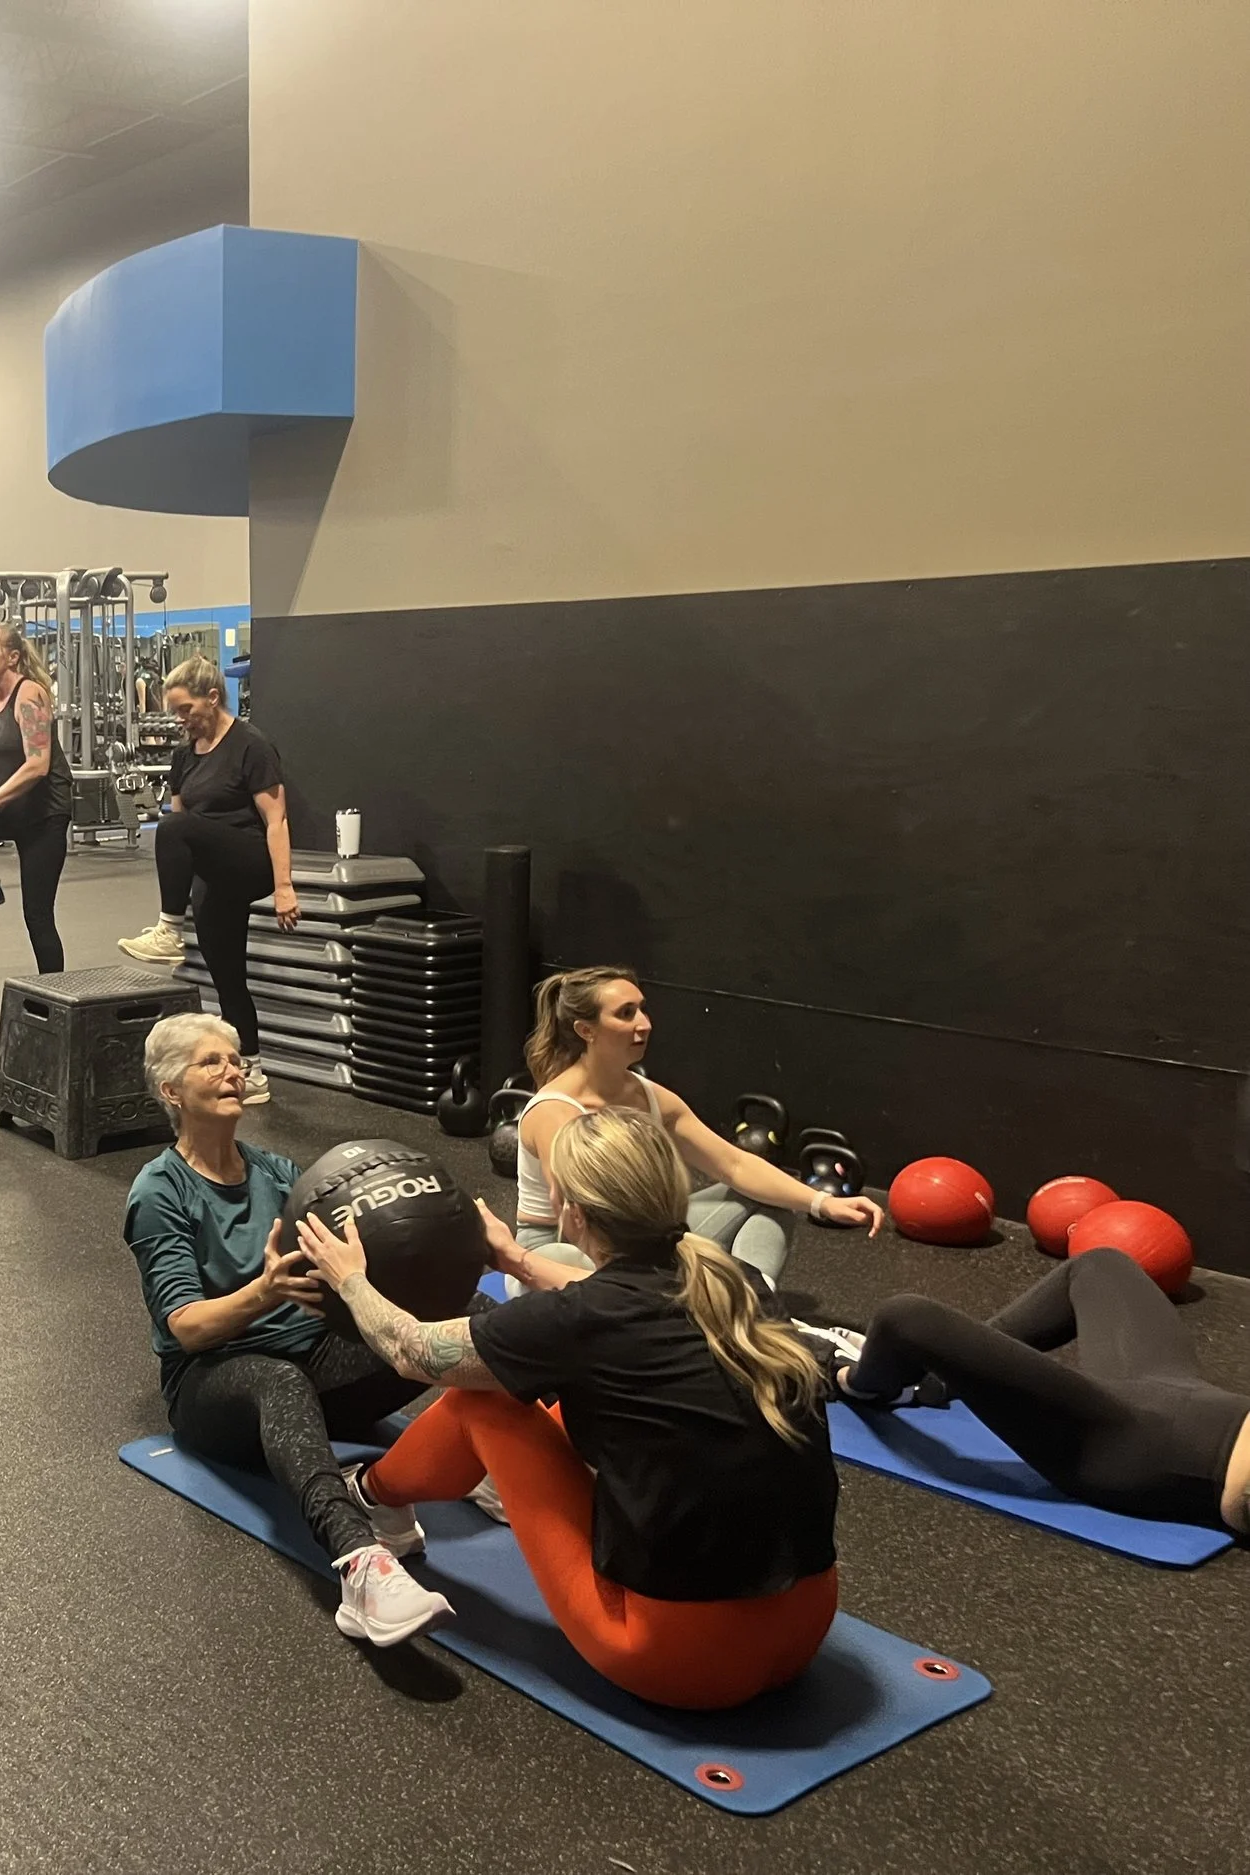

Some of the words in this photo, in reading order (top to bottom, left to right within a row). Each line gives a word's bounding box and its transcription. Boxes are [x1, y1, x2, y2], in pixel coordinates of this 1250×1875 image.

[1, 1084, 60, 1123] ROGUE
[98, 1099, 165, 1122] ROG
[331, 1175, 442, 1230] ROGUE
